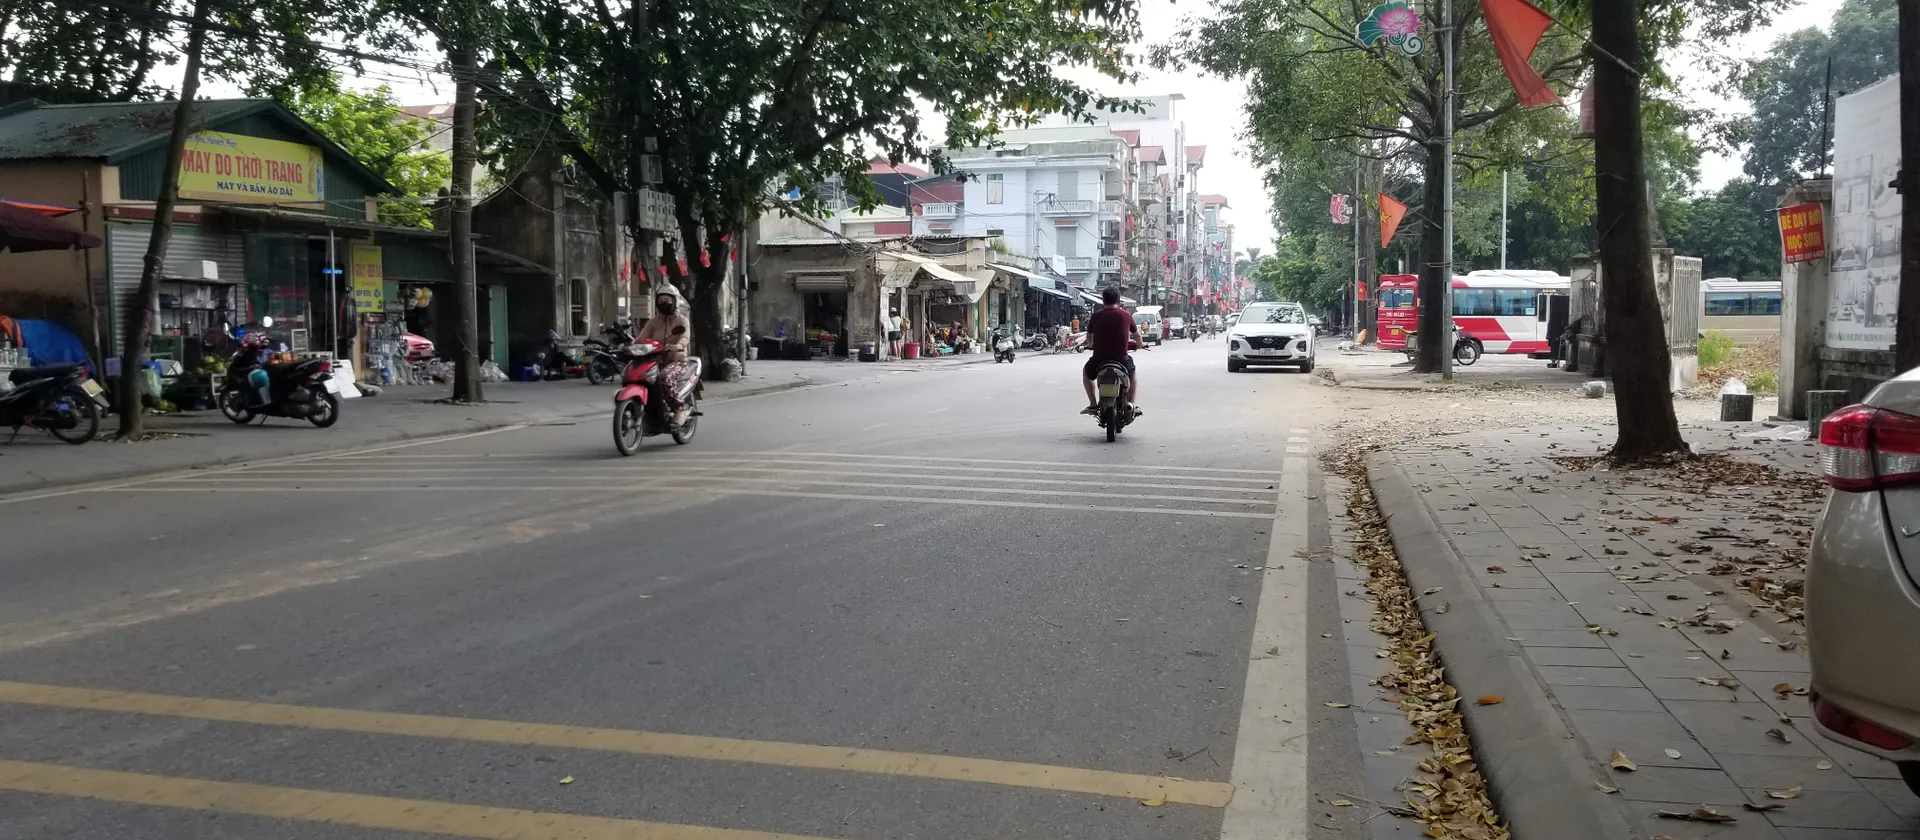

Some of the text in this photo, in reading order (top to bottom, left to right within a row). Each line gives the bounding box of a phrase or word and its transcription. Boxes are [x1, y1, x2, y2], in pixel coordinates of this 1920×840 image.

[182, 148, 211, 174] MAY
[265, 159, 303, 184] TRANG
[217, 180, 293, 196] MAY VÀ BÁN ÁO DÀI
[1803, 231, 1821, 247] SINH
